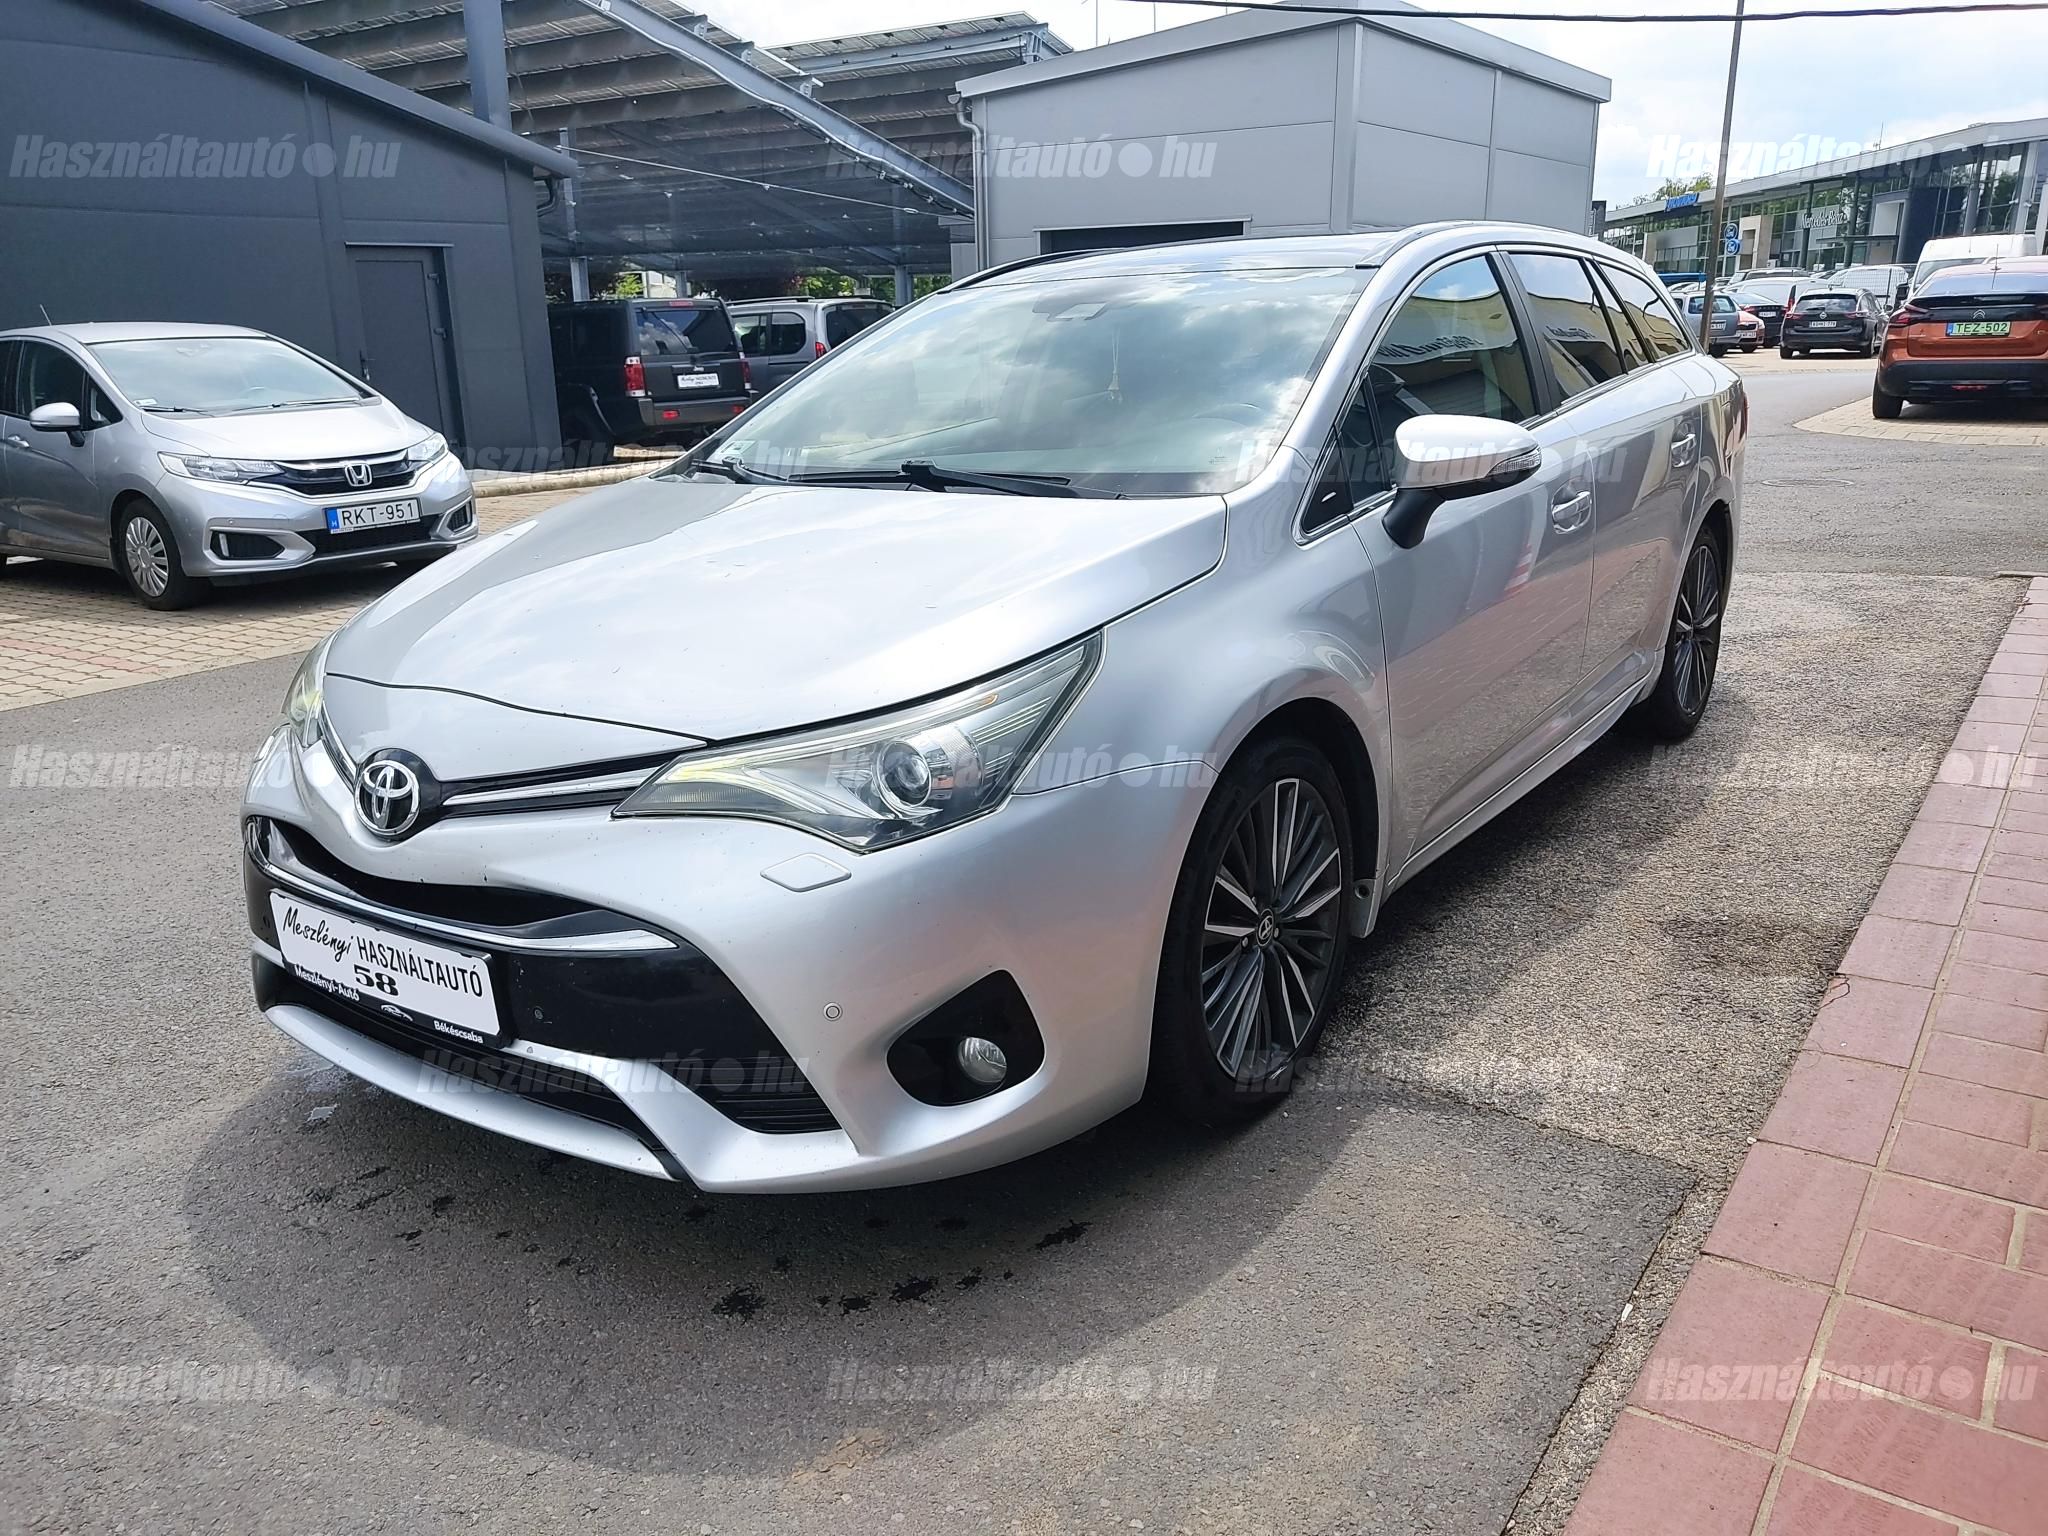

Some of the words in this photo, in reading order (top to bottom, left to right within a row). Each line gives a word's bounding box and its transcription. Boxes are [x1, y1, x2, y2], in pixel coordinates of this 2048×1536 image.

[1956, 322, 2008, 333] TEZ-502
[341, 502, 414, 526] RKT-951
[357, 936, 483, 998] HASZNÁLTAUTÓ
[354, 964, 399, 997] 58
[434, 1020, 484, 1044] Békéscsaba
